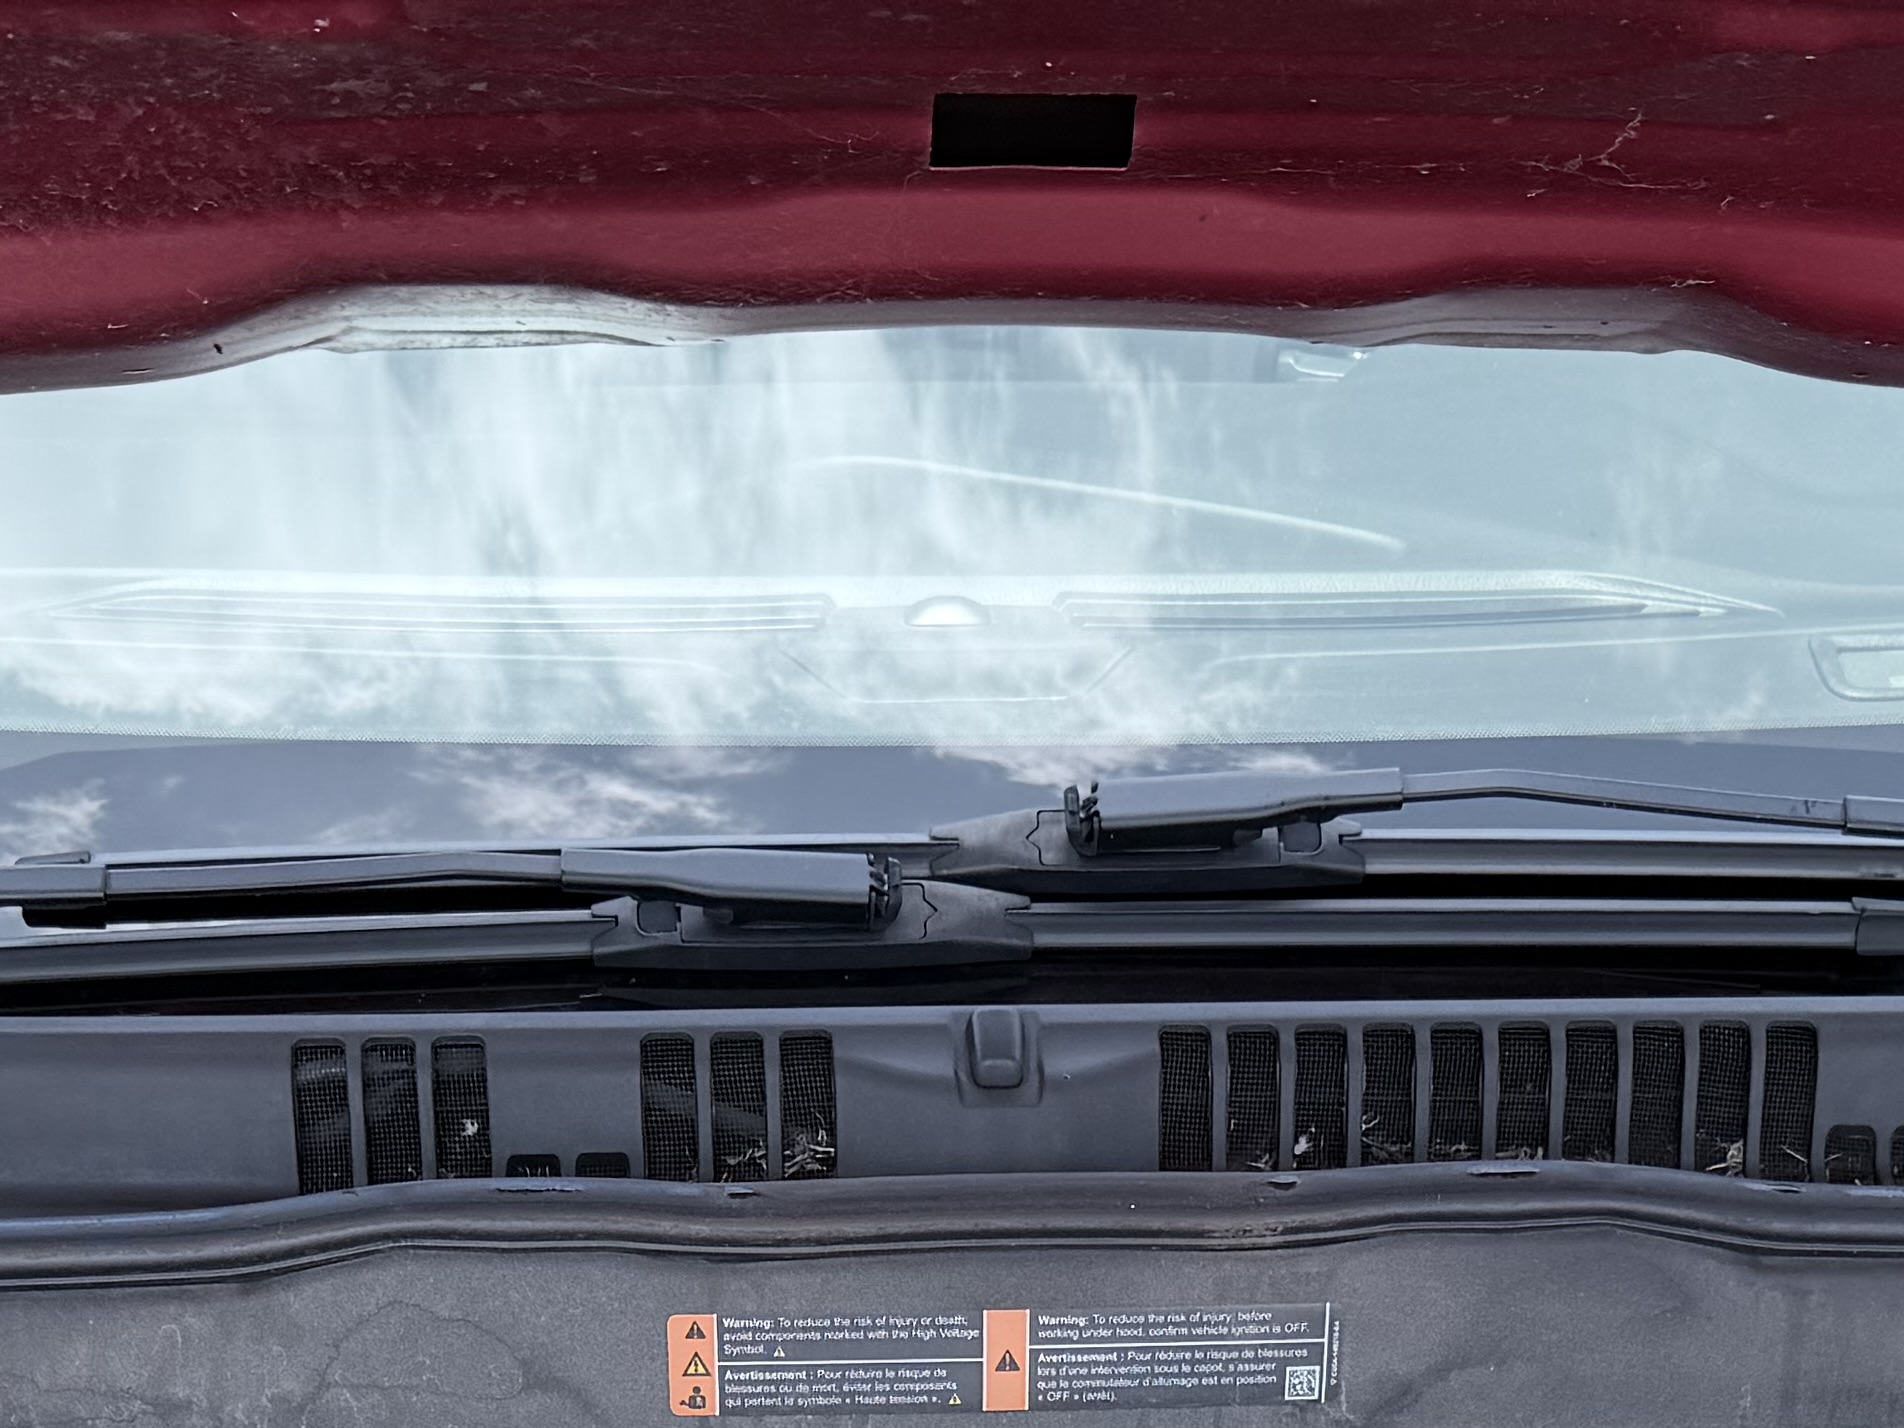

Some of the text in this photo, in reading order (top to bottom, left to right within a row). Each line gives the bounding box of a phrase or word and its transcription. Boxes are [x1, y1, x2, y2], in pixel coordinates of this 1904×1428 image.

[723, 1318, 775, 1330] Warning:
[778, 1318, 791, 1327] To
[794, 1318, 830, 1327] reduce
[834, 1317, 850, 1326] the
[853, 1317, 872, 1326] risk
[875, 1316, 886, 1325] of
[1038, 1315, 1089, 1328] Warning:
[1092, 1314, 1105, 1325] To
[1108, 1315, 1145, 1324] reduce
[1148, 1314, 1165, 1323] the
[1168, 1313, 1186, 1323] risk
[1190, 1312, 1200, 1322] of
[1238, 1311, 1272, 1321] before
[723, 1328, 980, 1342] avoid components marked with the High Voltage
[1038, 1329, 1079, 1340] working
[1082, 1328, 1112, 1338] under
[1148, 1326, 1188, 1336] confirm
[1191, 1324, 1228, 1334] vehicle
[1231, 1324, 1270, 1336] ignition
[1272, 1324, 1281, 1333] is
[724, 1345, 767, 1356] Symbol.
[1038, 1351, 1118, 1362] Avertissement
[1127, 1350, 1152, 1360] Pour
[1155, 1349, 1192, 1360] réduire
[1195, 1349, 1204, 1359] le
[1207, 1348, 1240, 1360] risque
[1242, 1348, 1254, 1358] de
[1258, 1347, 1308, 1358] blessures
[725, 1370, 806, 1380] Avertissement
[817, 1370, 842, 1379] Pour
[845, 1369, 883, 1378] réduire
[886, 1369, 895, 1378] le
[898, 1369, 930, 1380] risque
[933, 1368, 947, 1377] de
[1037, 1366, 1056, 1376] lors
[1090, 1363, 1152, 1375] intervention
[1154, 1364, 1178, 1373] sous
[1181, 1362, 1191, 1372] le
[725, 1383, 776, 1394] blessures
[779, 1384, 793, 1392] ou
[796, 1383, 809, 1392] de
[842, 1381, 872, 1391] éviter
[875, 1381, 891, 1391] les
[893, 1381, 958, 1393] composants
[1037, 1380, 1056, 1390] que
[1059, 1378, 1069, 1388] le
[1072, 1377, 1140, 1388] commutateur
[1202, 1376, 1218, 1384] est
[1220, 1376, 1234, 1384] en
[1236, 1373, 1276, 1386] position
[725, 1396, 741, 1408] qui
[745, 1396, 781, 1407] portent
[784, 1396, 794, 1405] le
[797, 1395, 842, 1407] symbole
[855, 1395, 887, 1404] Haute
[889, 1394, 929, 1404] tension
[1047, 1391, 1070, 1401] OFF
